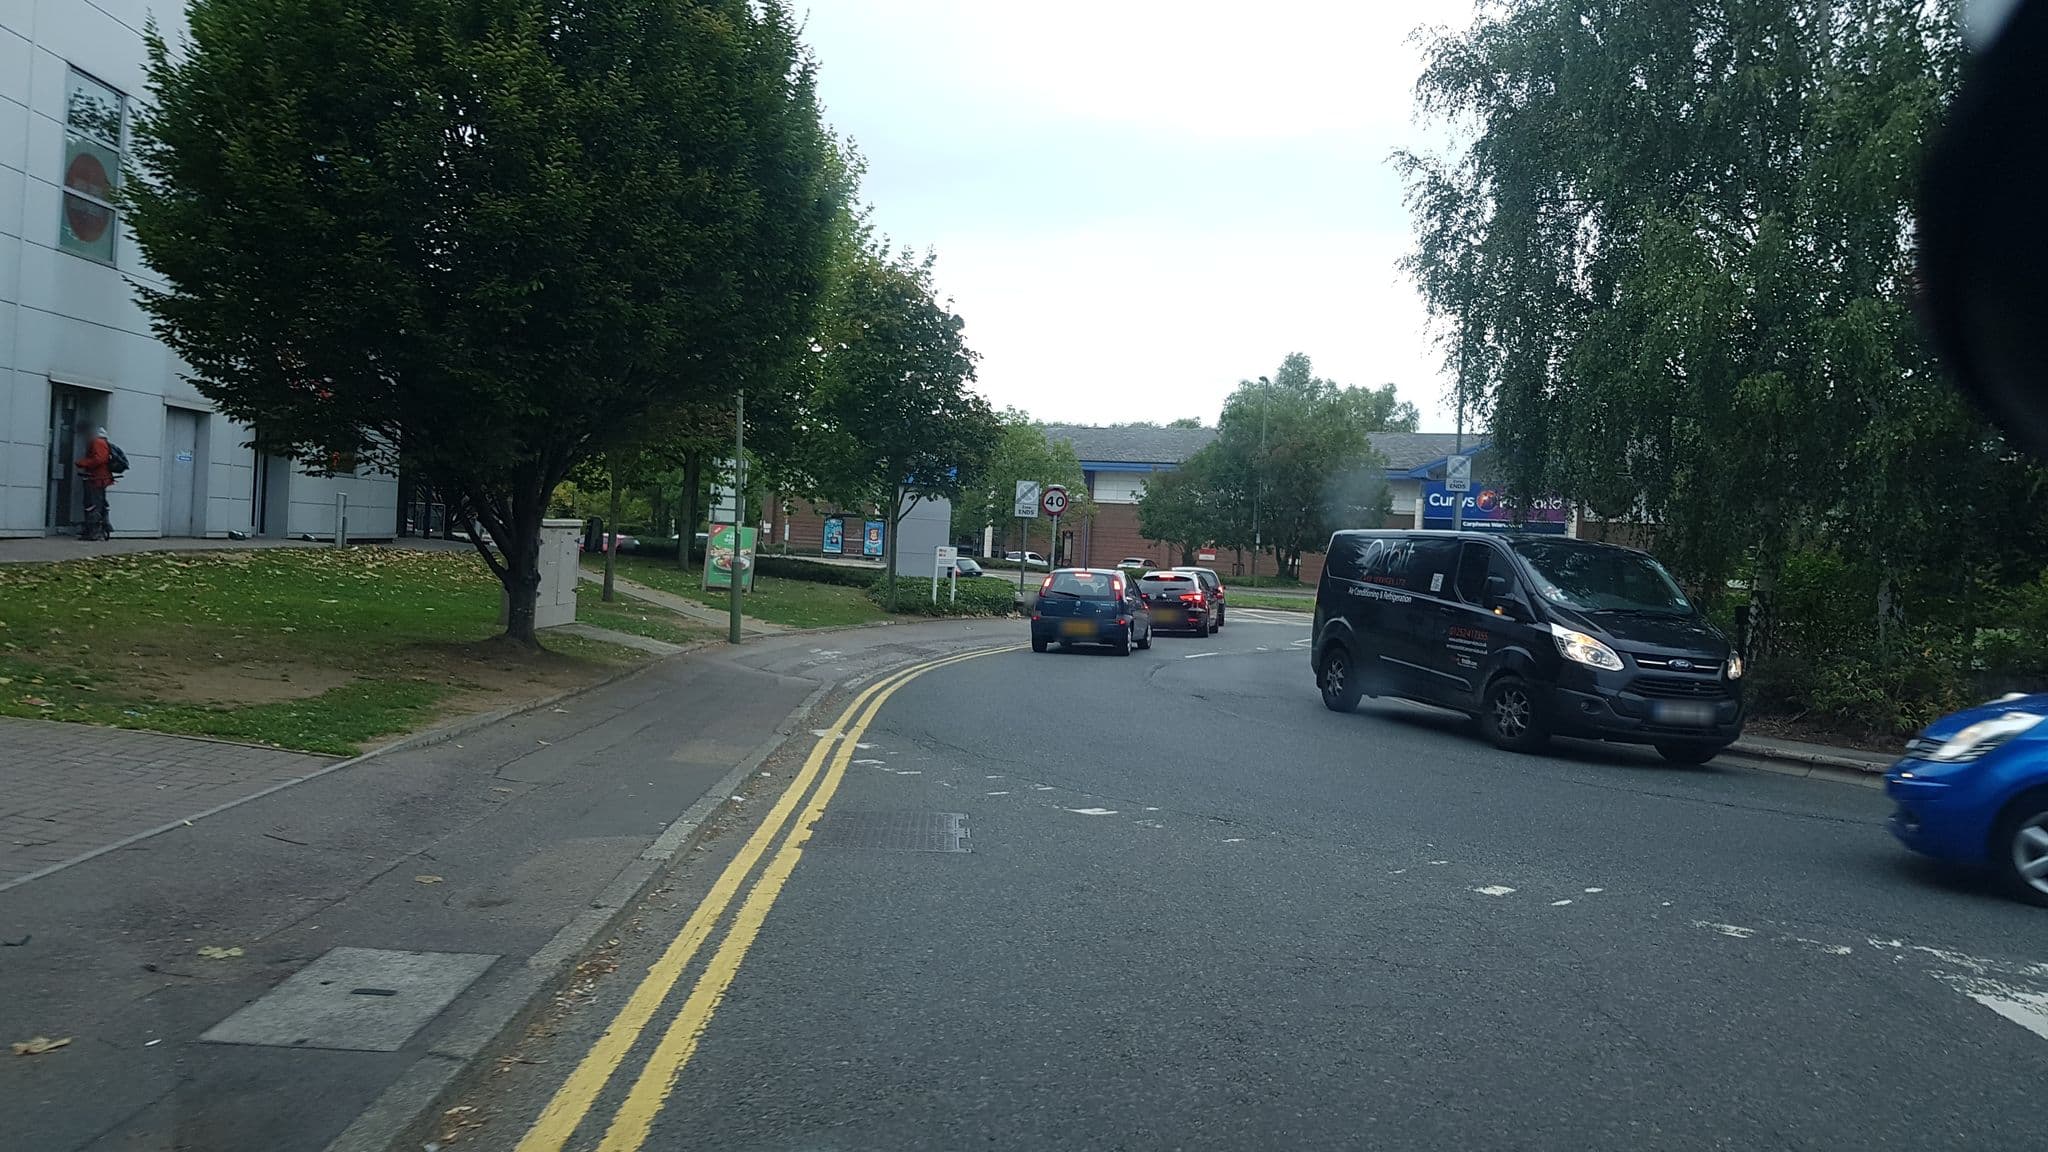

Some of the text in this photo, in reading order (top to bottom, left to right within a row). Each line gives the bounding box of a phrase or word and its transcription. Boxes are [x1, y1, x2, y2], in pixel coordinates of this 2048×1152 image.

[1045, 496, 1065, 507] 40
[1429, 493, 1475, 508] Curys
[1366, 539, 1415, 568] Orbit
[1353, 588, 1380, 600] Conditioning
[1383, 591, 1412, 603] Refrigeration
